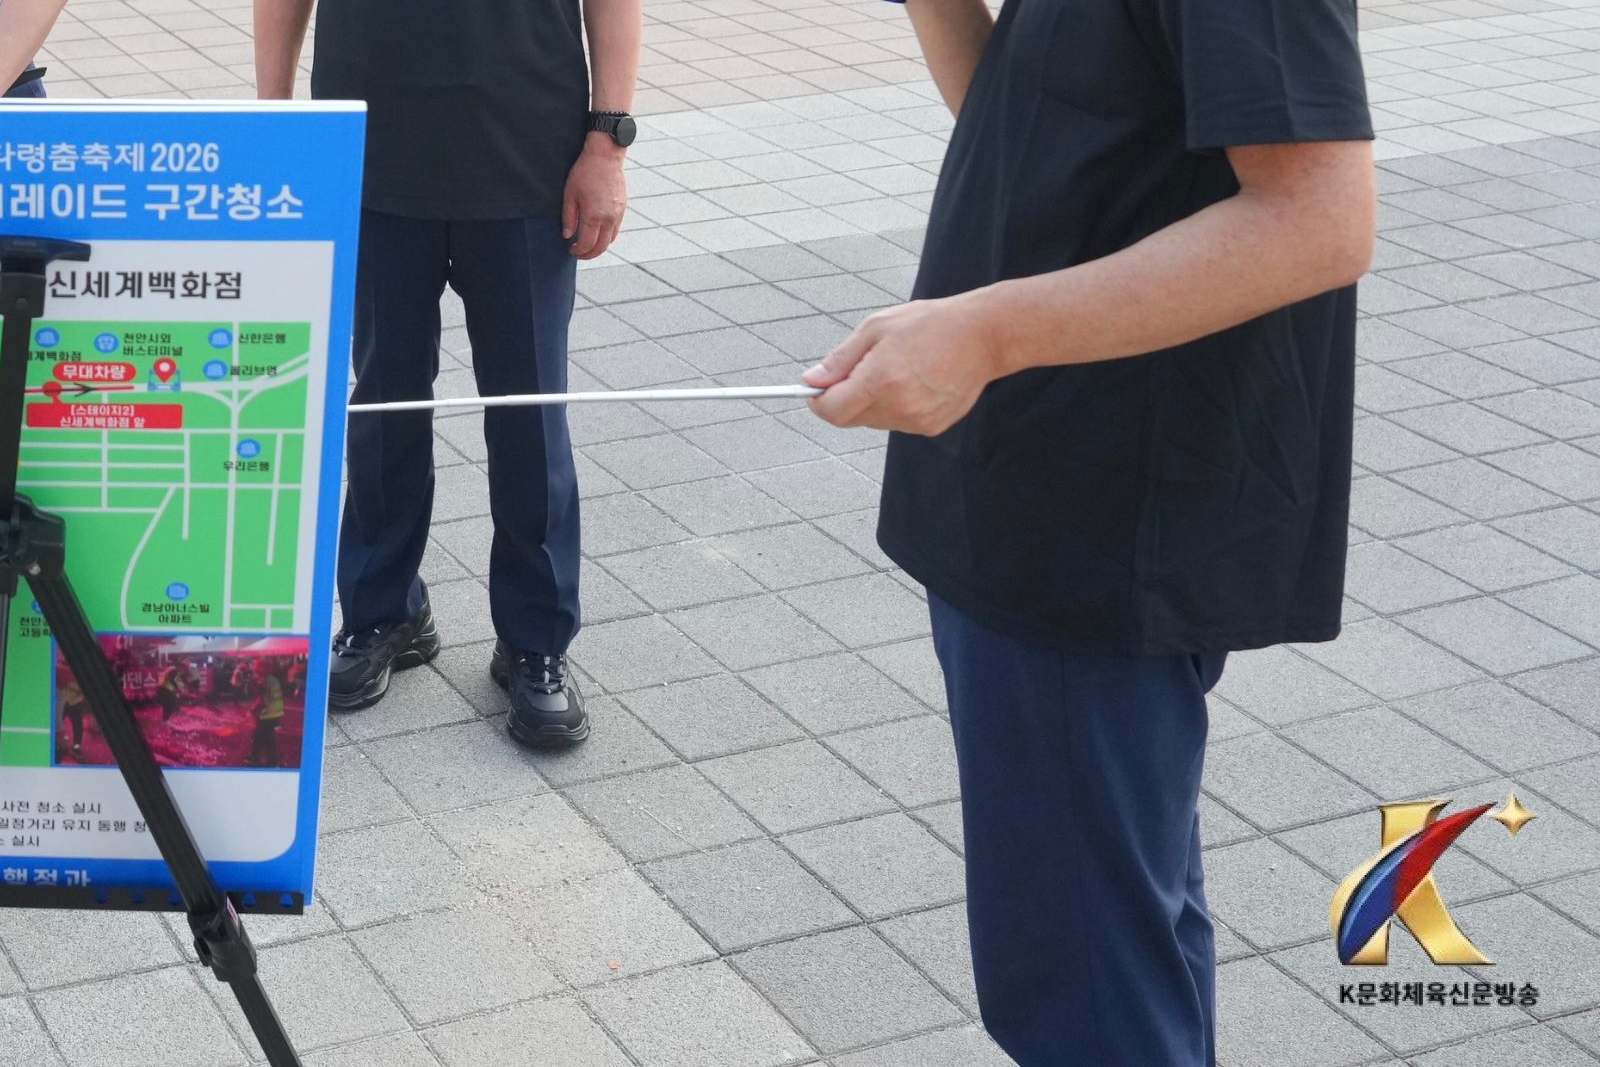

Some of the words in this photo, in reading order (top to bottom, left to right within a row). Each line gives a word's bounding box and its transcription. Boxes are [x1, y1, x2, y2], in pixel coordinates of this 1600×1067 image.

[144, 183, 304, 221] 구간청소
[48, 270, 243, 300] 신세계백화점
[123, 332, 172, 344] 천안시외
[238, 332, 287, 344] 신한은행
[29, 350, 82, 361] 계백화점
[122, 345, 183, 357] 버스터미널
[62, 364, 126, 379] 무대차량
[229, 365, 278, 377] 올리브영
[70, 405, 135, 417] [스테이지2]
[60, 416, 130, 428] 신세계백화점
[223, 460, 270, 472] 우리은행
[158, 614, 192, 625] 아파트
[1, 800, 30, 813] 사전
[37, 801, 66, 814] 청소
[72, 802, 101, 814] 실시
[62, 819, 91, 832] 유지
[133, 821, 150, 833] 청
[11, 835, 40, 846] 실시
